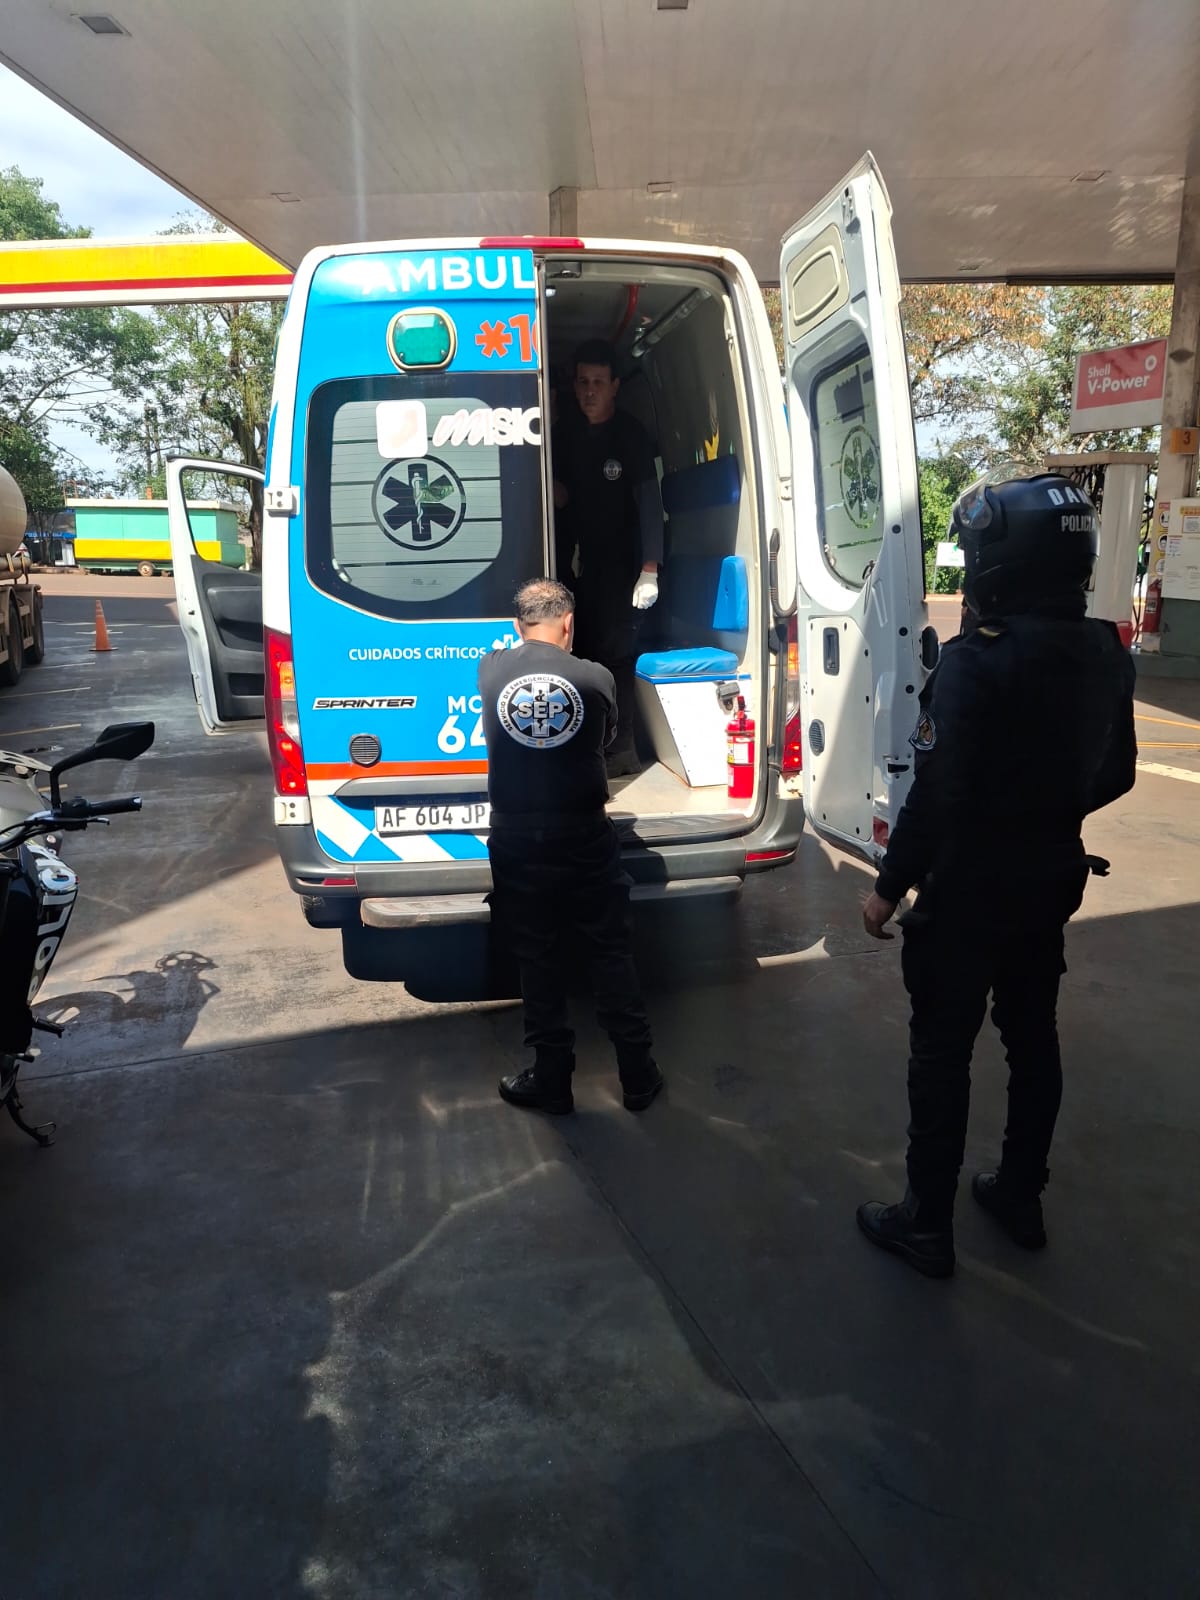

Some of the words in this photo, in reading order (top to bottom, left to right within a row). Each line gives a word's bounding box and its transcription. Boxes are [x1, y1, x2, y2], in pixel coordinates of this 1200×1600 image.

[1087, 363, 1111, 378] Shell
[1087, 375, 1150, 395] V-Power
[1183, 430, 1192, 446] 3
[349, 647, 422, 661] CUIDADOS
[425, 645, 486, 660] CRÍTICOS
[315, 698, 415, 709] SPRINTER
[517, 701, 564, 719] SEP
[500, 701, 513, 732] SERVICIO
[383, 807, 406, 828] AF
[416, 805, 453, 826] 604
[461, 804, 485, 824] JP
